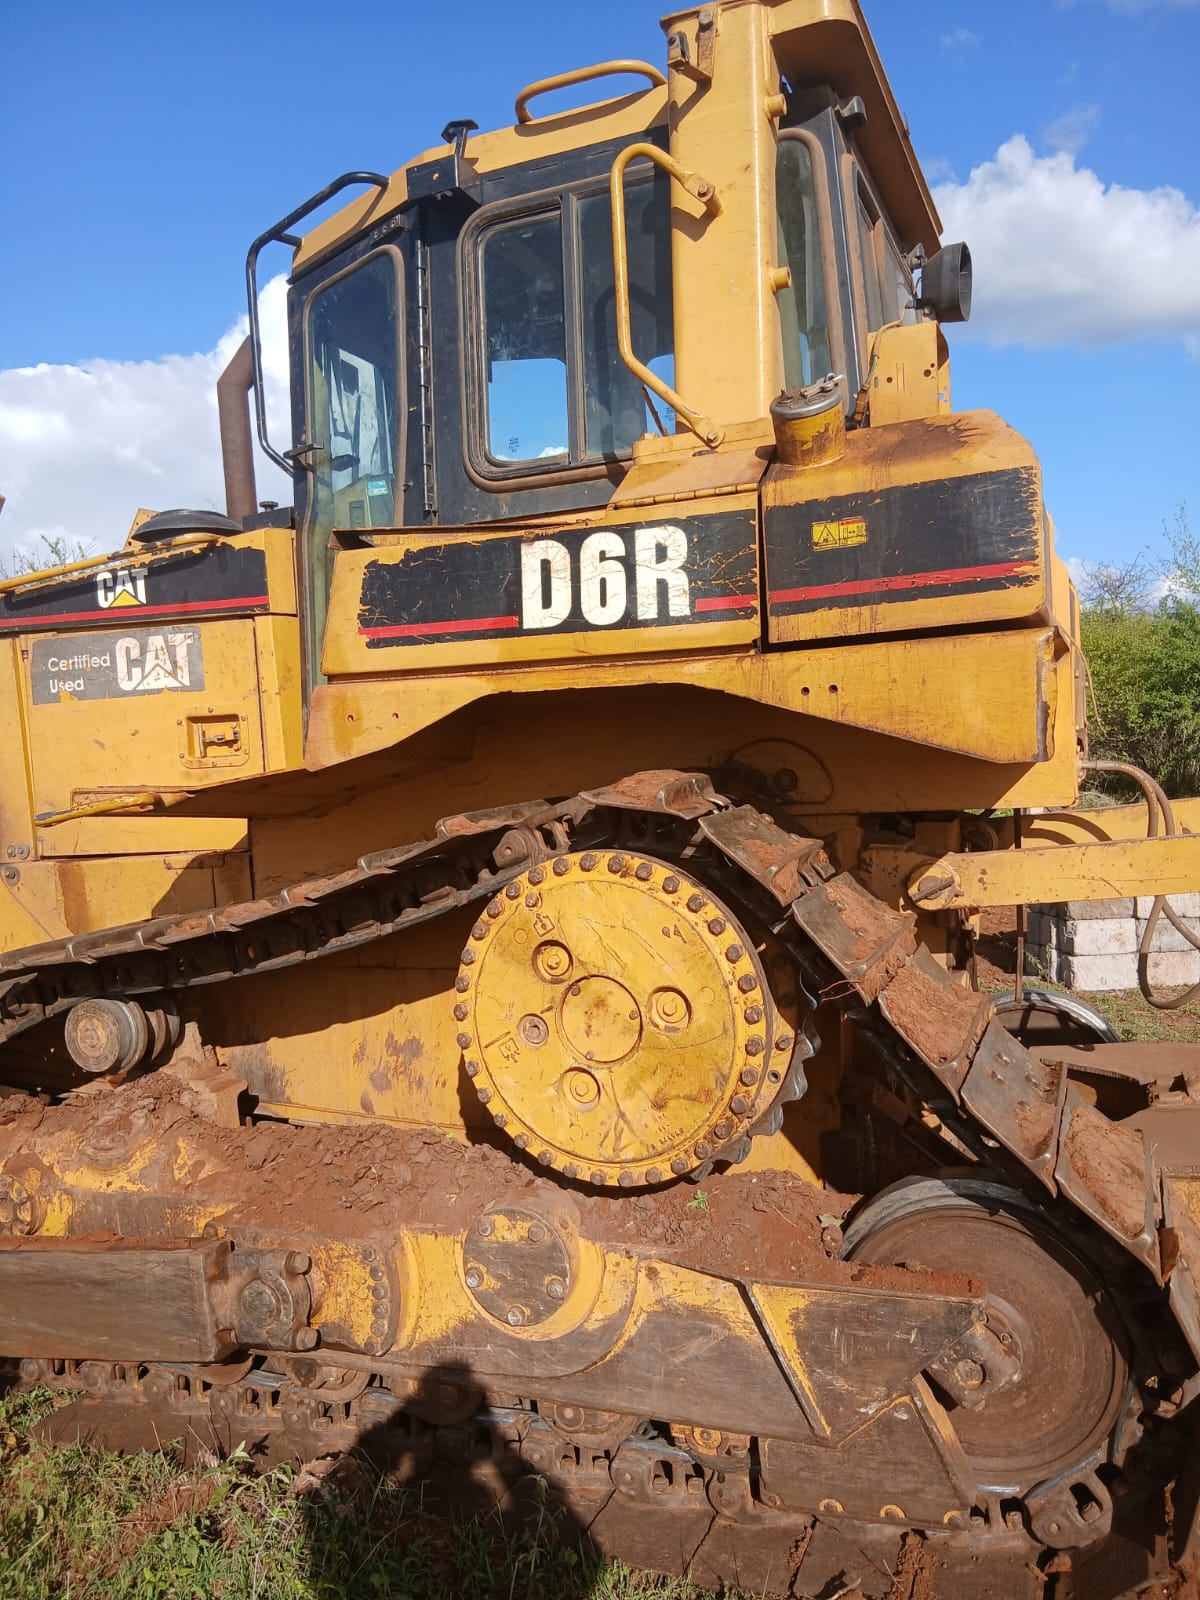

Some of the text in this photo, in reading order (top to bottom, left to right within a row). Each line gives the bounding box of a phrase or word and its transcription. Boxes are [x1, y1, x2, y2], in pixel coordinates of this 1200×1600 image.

[96, 567, 149, 609] CAT
[521, 525, 691, 630] D6R
[48, 652, 111, 672] Certified
[115, 632, 194, 691] CAT
[50, 679, 85, 693] Used
